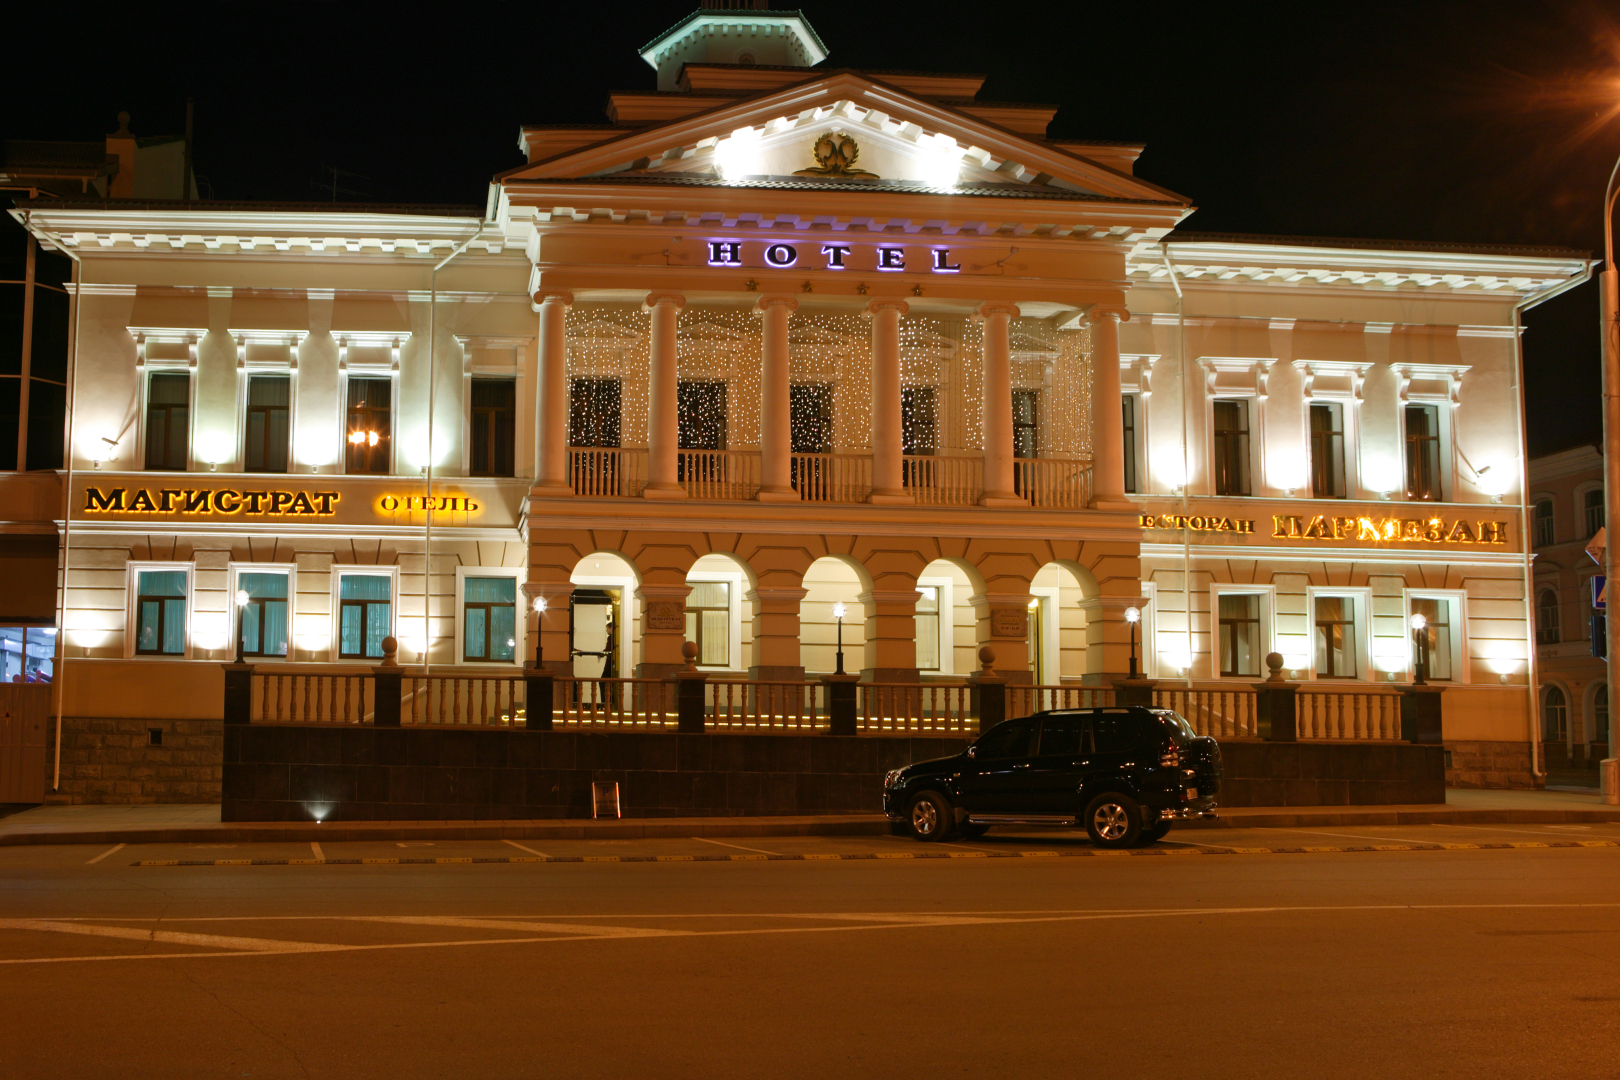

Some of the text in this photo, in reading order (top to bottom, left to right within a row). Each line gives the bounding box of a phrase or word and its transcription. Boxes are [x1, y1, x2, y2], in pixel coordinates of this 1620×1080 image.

[708, 242, 961, 273] HOTEL
[84, 486, 479, 517] МАГИСТРАТ ОТЕЛЬ
[1139, 514, 1508, 544] ЕСТОРАН ПАРМЕЗАН
